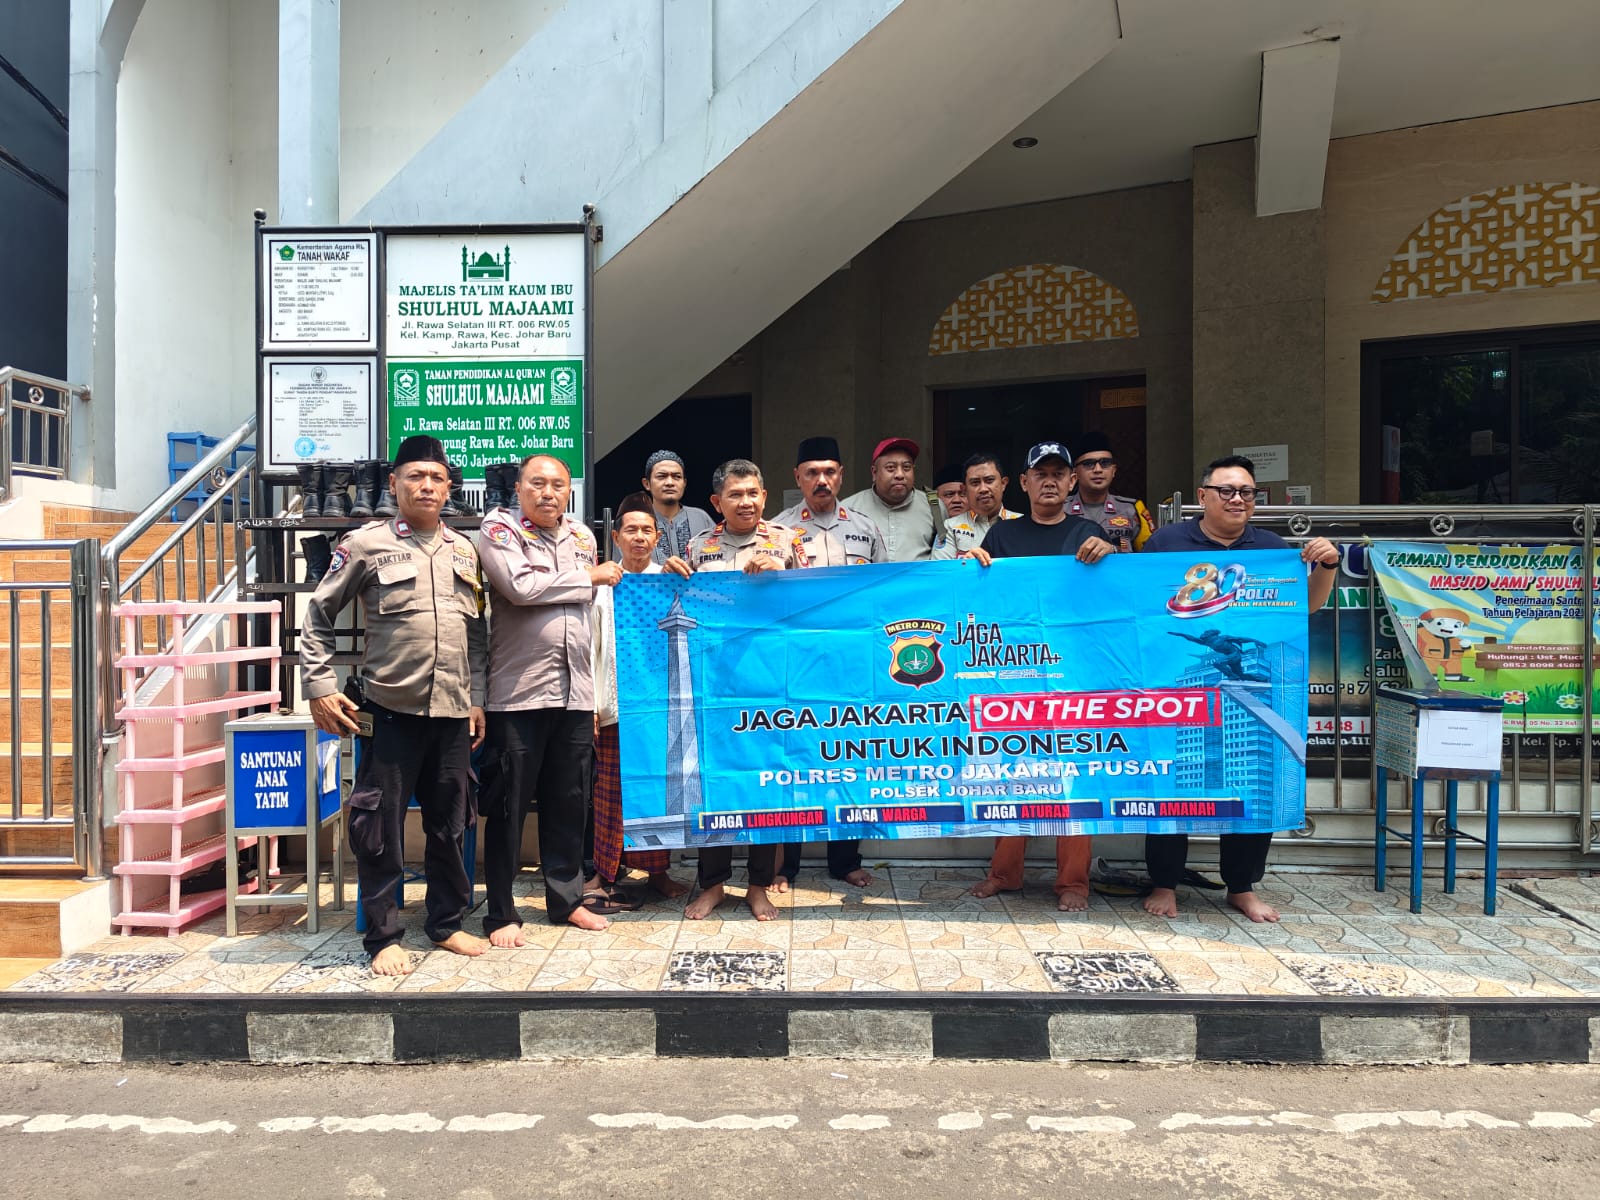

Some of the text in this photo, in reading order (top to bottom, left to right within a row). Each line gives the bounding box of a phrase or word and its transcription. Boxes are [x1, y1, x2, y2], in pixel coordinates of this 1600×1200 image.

[297, 251, 350, 261] TANAH WAKAF
[399, 284, 573, 296] MAJELIS TA'LIM KAUM IBU
[398, 300, 574, 316] SHULHUL MAJAAMI
[402, 321, 413, 329] Jl.
[417, 321, 444, 329] Rawa
[447, 321, 484, 329] Selatan
[518, 320, 535, 328] 006
[538, 320, 570, 328] RW.05
[400, 330, 571, 341] Kel. Kamp. Rawa, Kec. Johar Baru
[451, 340, 520, 349] Jakarta Pusat
[425, 368, 546, 381] TAMAN PENDIDIKAN AL QUR'AN
[426, 384, 484, 406] SHULHUL
[486, 383, 545, 405] MAJAAMI
[403, 416, 570, 431] Jl. Rawa Selatan III RT. 006 RW.05
[443, 435, 574, 452] pung Rawa Kec. Johar Baru
[1040, 443, 1060, 455] M
[470, 454, 506, 468] Jakarta
[845, 534, 870, 543] POLRI
[1386, 552, 1450, 569] TAMAN
[1454, 554, 1568, 569] PENDIDIKAN
[1429, 575, 1489, 590] MASJID
[1490, 576, 1535, 591] JAMI'
[1235, 588, 1279, 601] POLRI
[1495, 596, 1555, 607] Penerimaan
[1555, 595, 1585, 606] Santr
[1481, 608, 1514, 618] Tahun
[1514, 608, 1561, 619] Pelajaran
[886, 621, 942, 634] METRO JAYA
[950, 618, 1003, 646] JAGA
[733, 695, 1204, 731] JAGA JAKARTA ON THE SPOT
[820, 732, 1129, 761] UNTUK INDONESIA
[1522, 737, 1545, 746] Kel.
[240, 751, 302, 769] SANTUNAN
[255, 770, 288, 787] ANAK
[759, 759, 1174, 787] POLRES METRO JAKARTA PUSAT
[870, 782, 1064, 799] POLSEK JOHAR BARU
[254, 791, 289, 809] YATIM
[846, 807, 927, 823] JAGA WARGA
[983, 803, 1070, 820] JAGA ATURAN
[1121, 800, 1216, 817] JAGA AMANAH
[711, 810, 824, 829] JAGA LINGKUNGAN
[677, 955, 773, 969] BATAS
